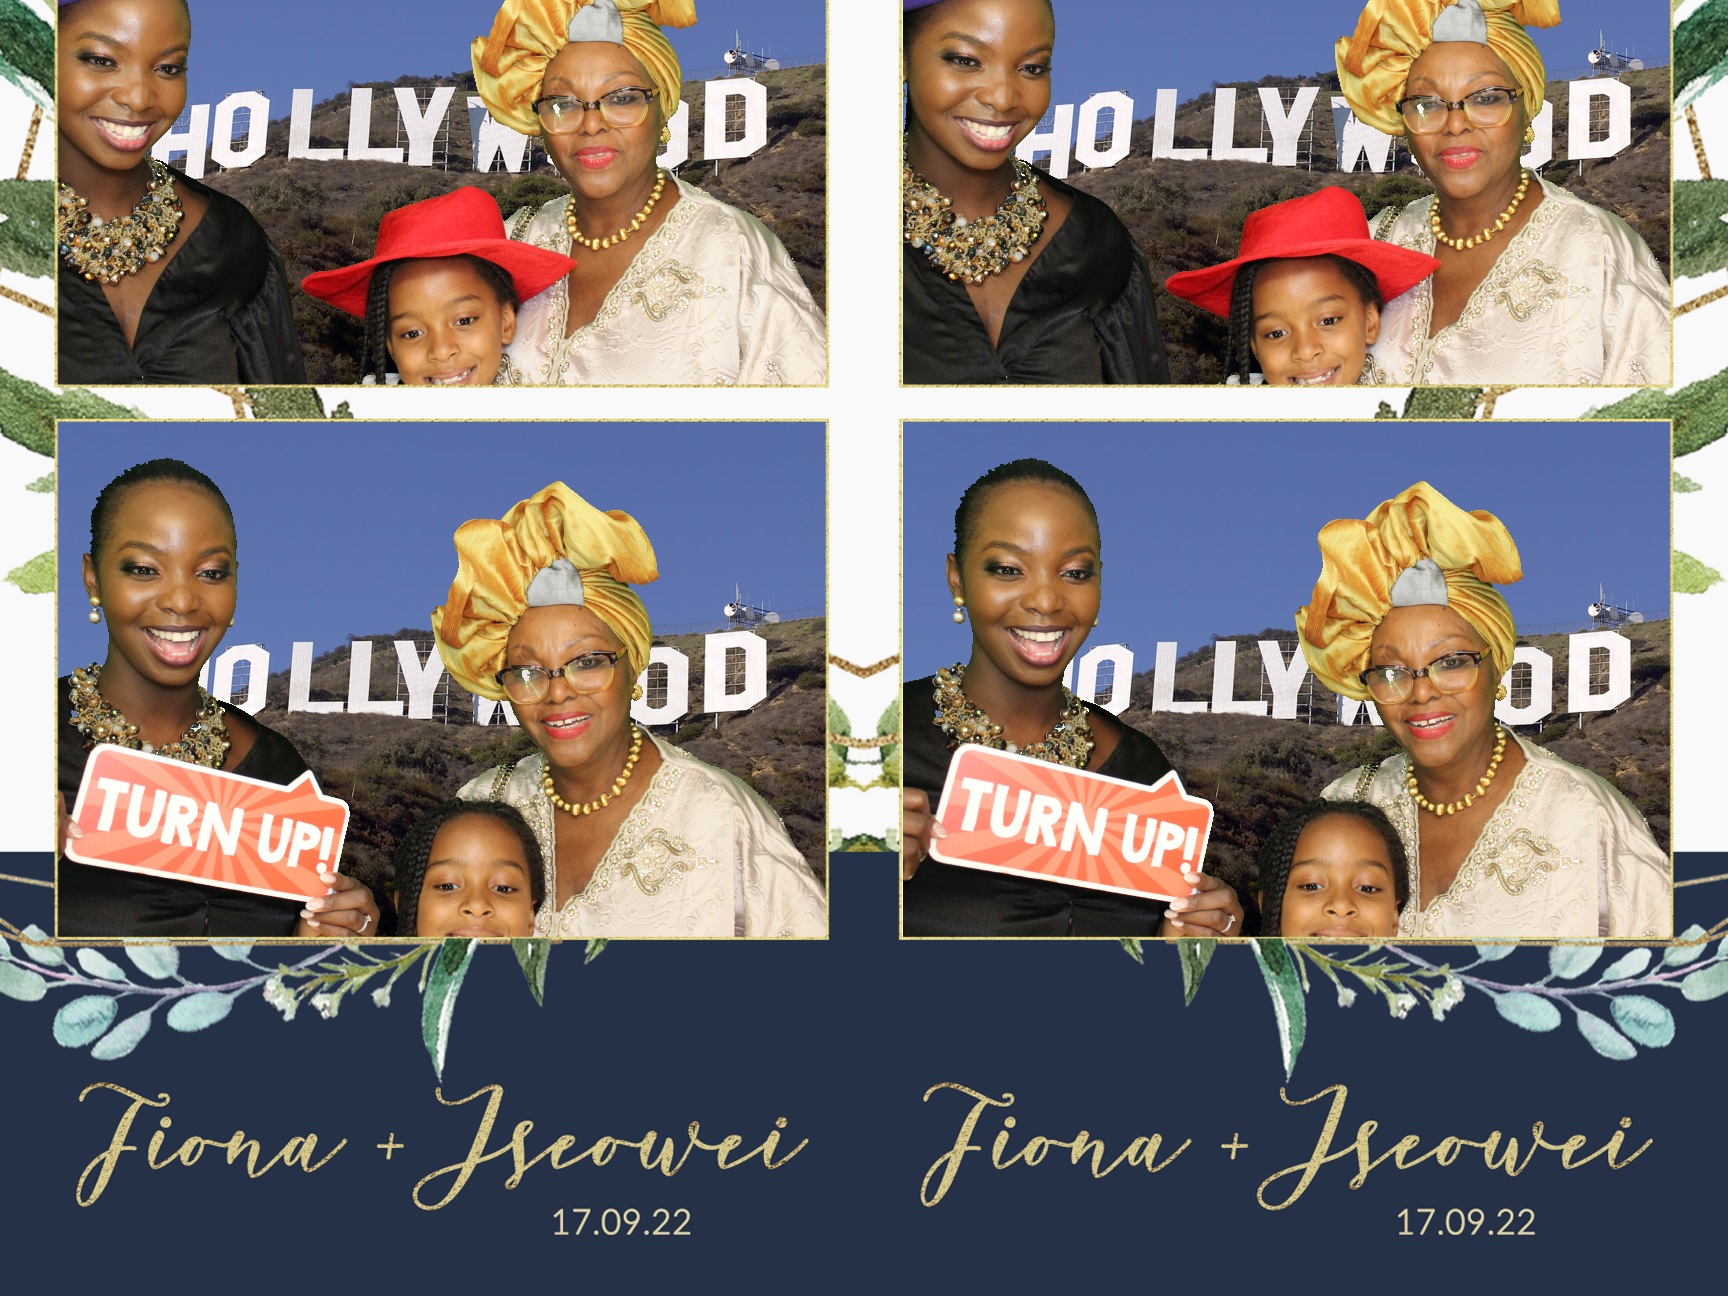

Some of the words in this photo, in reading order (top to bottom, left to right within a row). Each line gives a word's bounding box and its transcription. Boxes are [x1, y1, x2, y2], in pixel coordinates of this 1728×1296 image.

[97, 776, 245, 856] TURN
[257, 813, 335, 875] UP!
[961, 776, 1109, 856] TURN
[1121, 813, 1199, 875] UP!
